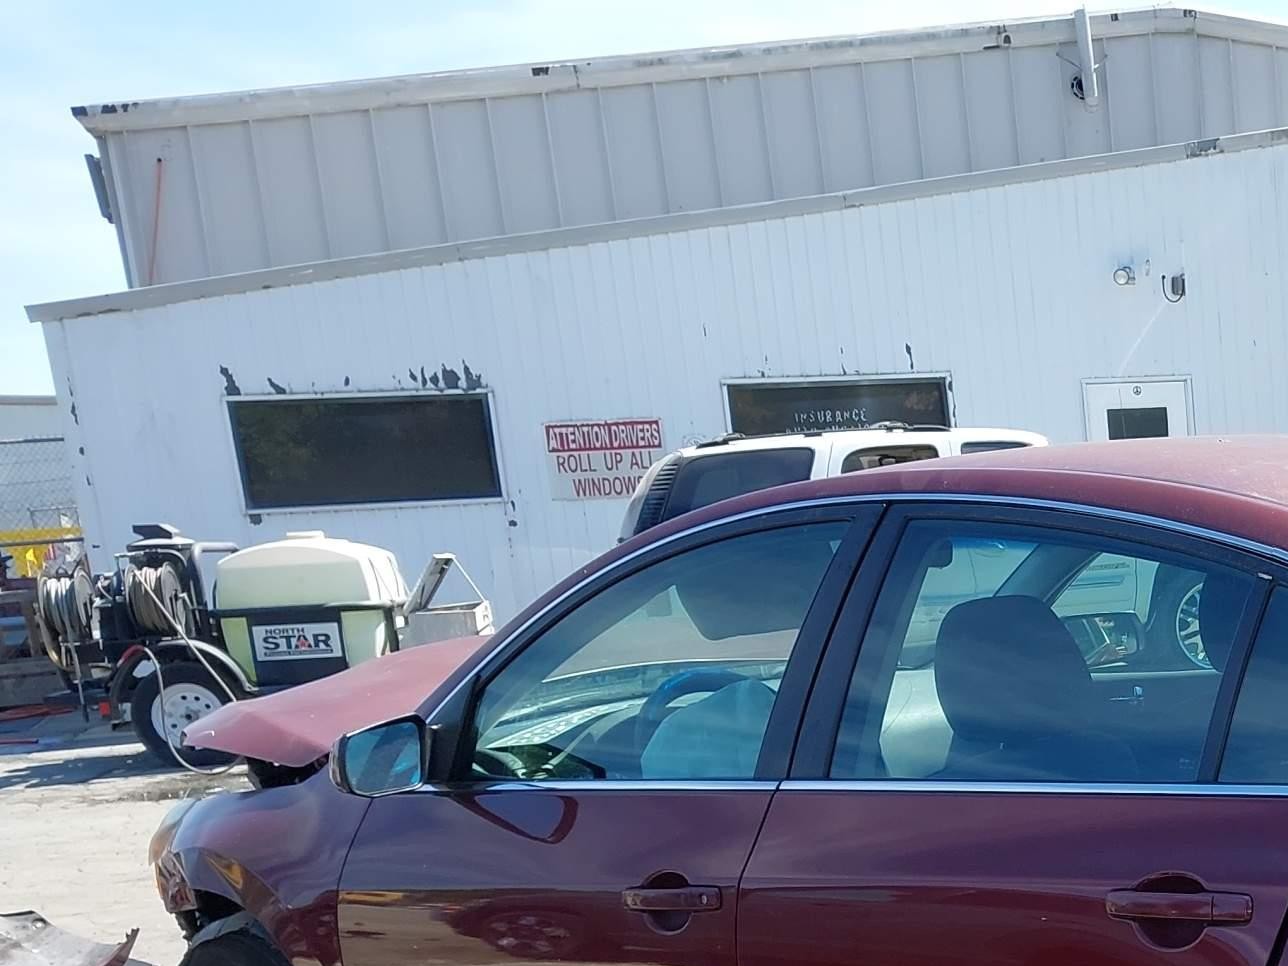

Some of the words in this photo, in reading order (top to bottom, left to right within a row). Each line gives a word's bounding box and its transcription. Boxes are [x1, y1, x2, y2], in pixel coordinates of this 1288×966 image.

[794, 408, 867, 423] INSURANCE
[549, 426, 609, 451] ATTENTION
[611, 423, 660, 448] DRIVERS
[556, 453, 597, 474] ROLL
[603, 451, 623, 471] UP
[264, 627, 305, 636] NORTH
[263, 634, 332, 650] STAR
